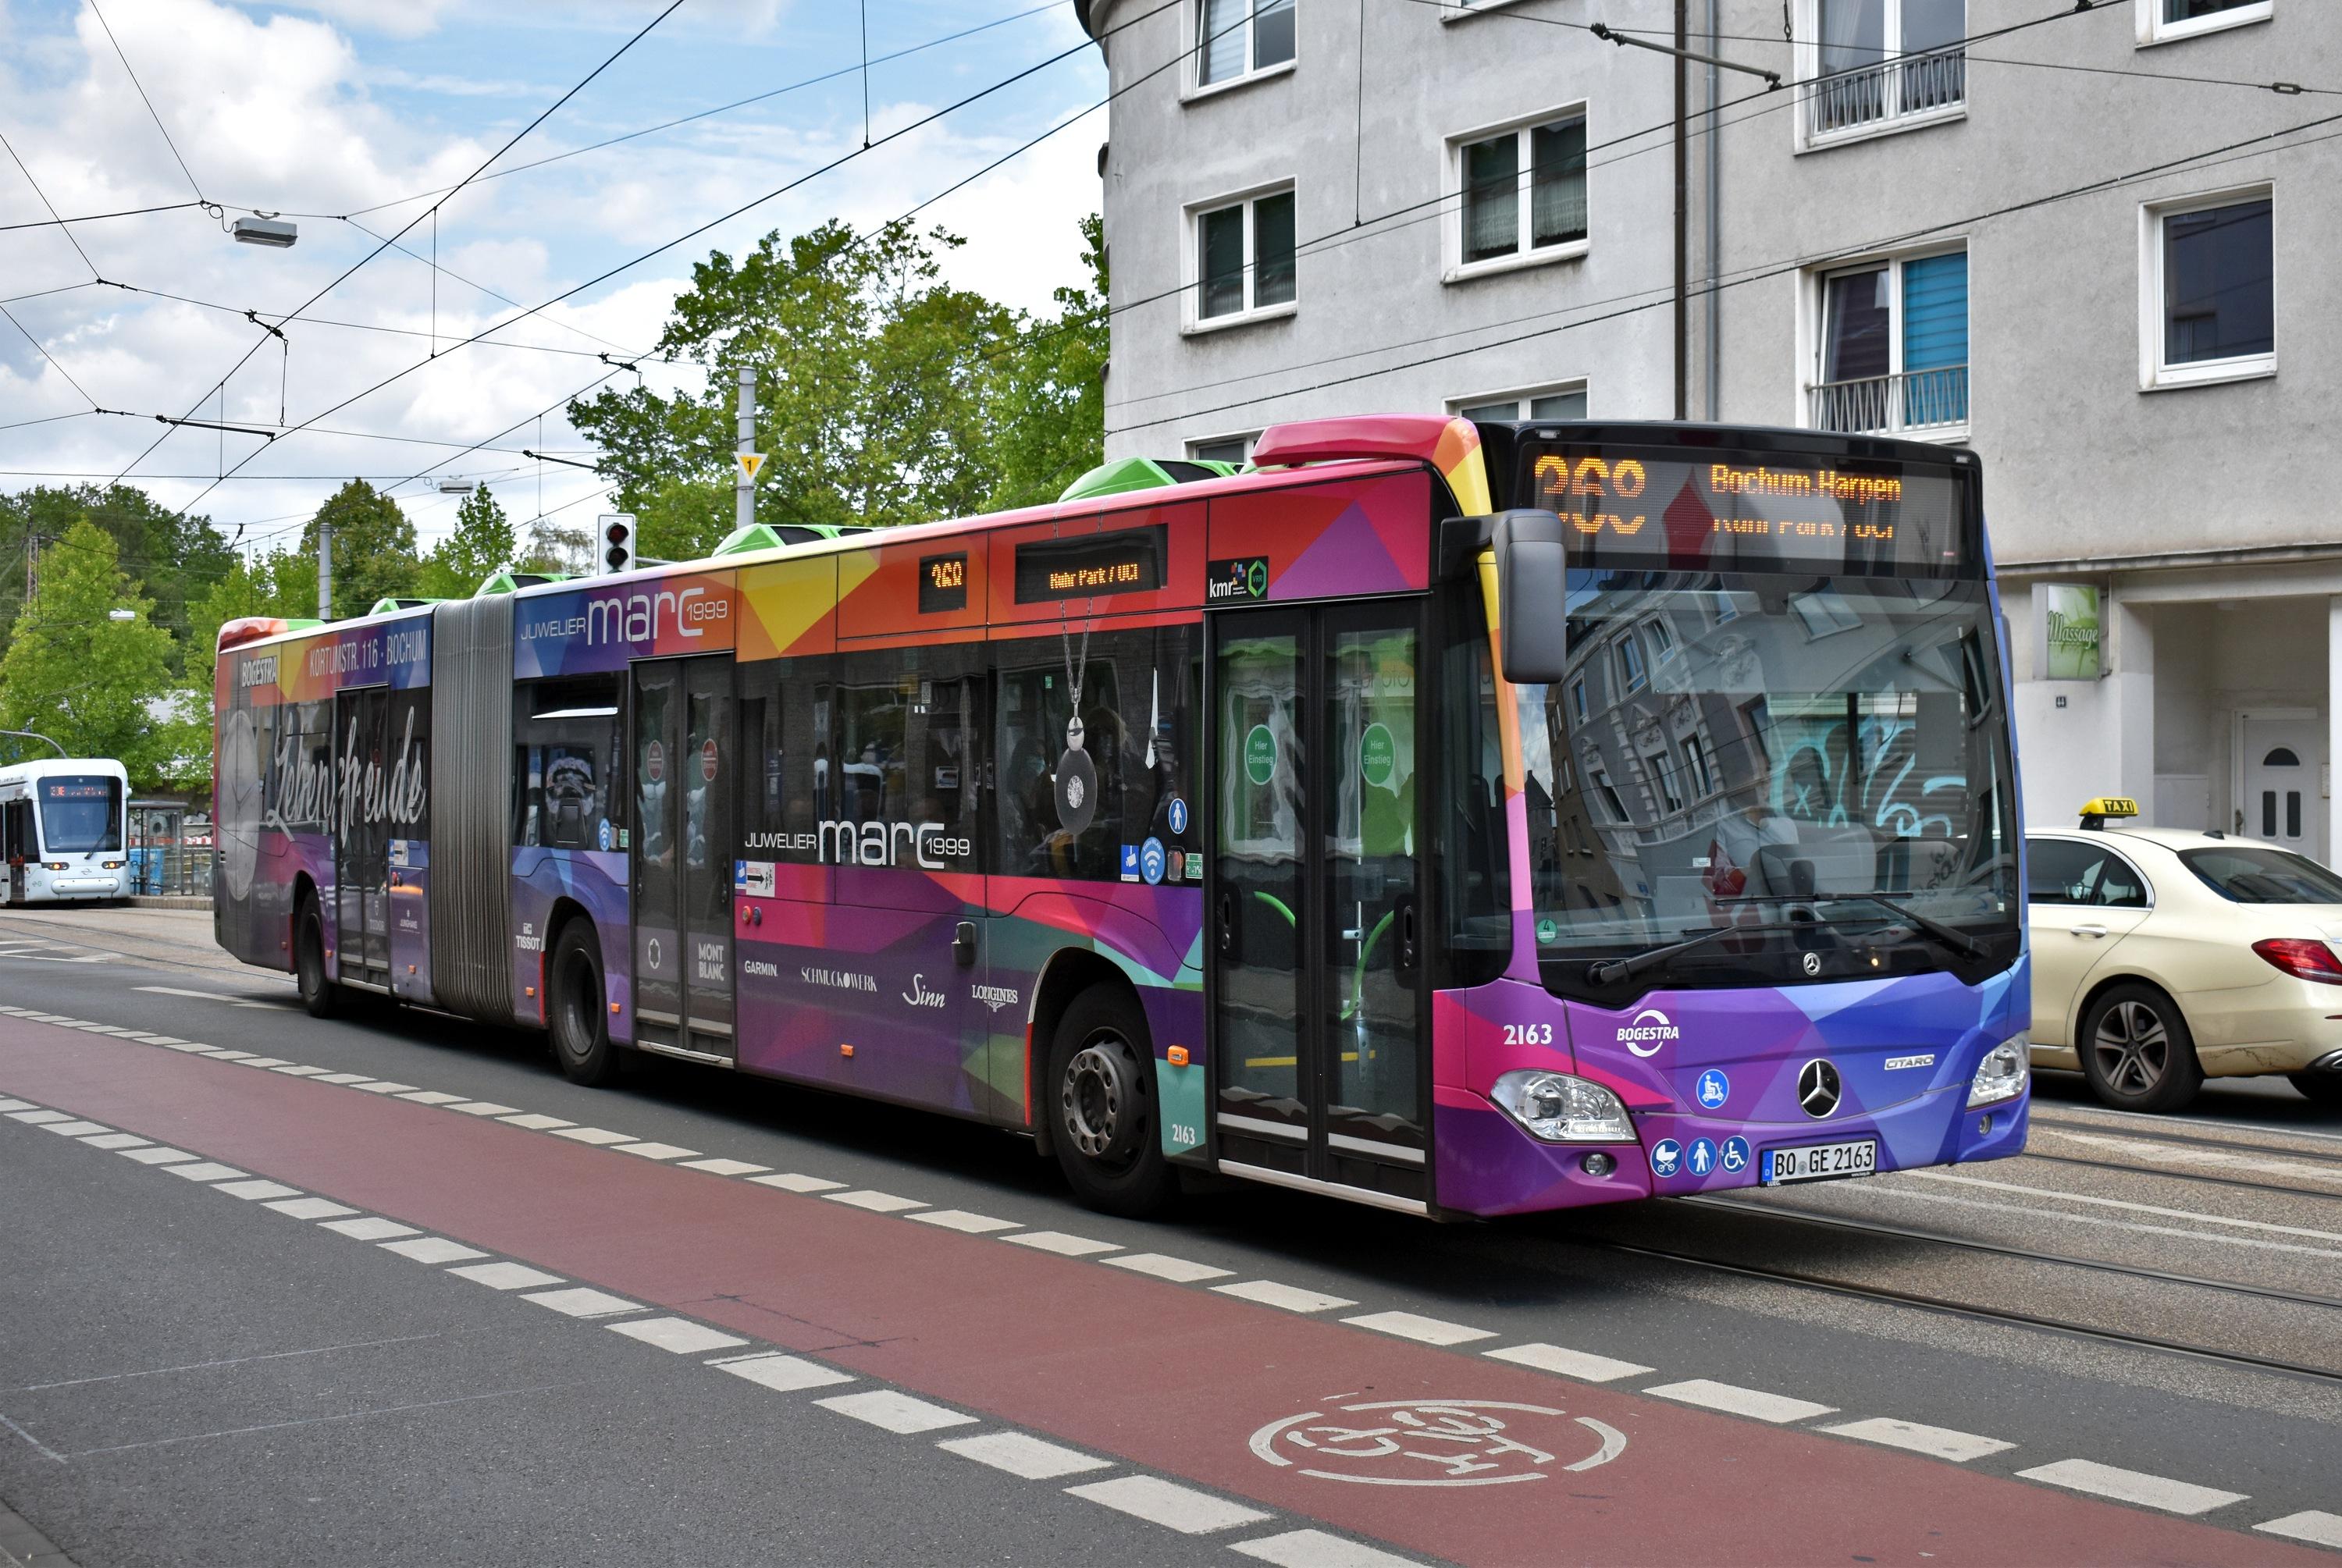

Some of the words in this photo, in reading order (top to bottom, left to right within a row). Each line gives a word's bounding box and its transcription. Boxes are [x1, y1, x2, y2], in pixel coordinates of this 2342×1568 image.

[746, 459, 752, 472] 1
[1079, 567, 1106, 586] Park
[1117, 564, 1138, 581] UCI
[1252, 574, 1262, 583] VRR
[1209, 578, 1233, 598] kmr
[521, 617, 586, 640] JUWELIER
[587, 587, 704, 645] marc
[686, 599, 728, 621] 1999
[2047, 610, 2098, 649] Massage
[310, 641, 360, 677] KORTUMSTR.
[362, 638, 379, 669] 116
[386, 629, 426, 666] BOCHUM
[242, 656, 277, 688] BOGESTRA
[1254, 741, 1268, 751] Hier
[1370, 741, 1385, 750] Hier
[1248, 754, 1273, 765] Einstieg
[1364, 754, 1391, 766] Einstieg
[2104, 800, 2134, 812] TAXI
[745, 832, 817, 849] JUWELIER
[818, 820, 945, 869] marc
[925, 837, 970, 856] 1999
[1543, 920, 1550, 931] 4
[515, 935, 541, 951] TISSOT
[698, 942, 724, 962] MONT
[699, 961, 724, 981] BLANC
[745, 960, 778, 976] GARMIN
[902, 973, 945, 1008] Sinn
[972, 984, 1018, 1004] LONGINES
[1503, 1023, 1553, 1046] 2163
[1617, 1026, 1679, 1041] BOGESTRA
[1886, 1055, 1934, 1068] CITARO
[1172, 1123, 1196, 1145] 2163
[1774, 1152, 1796, 1177] BO
[1810, 1149, 1829, 1172] GE
[1834, 1144, 1873, 1171] 2163
